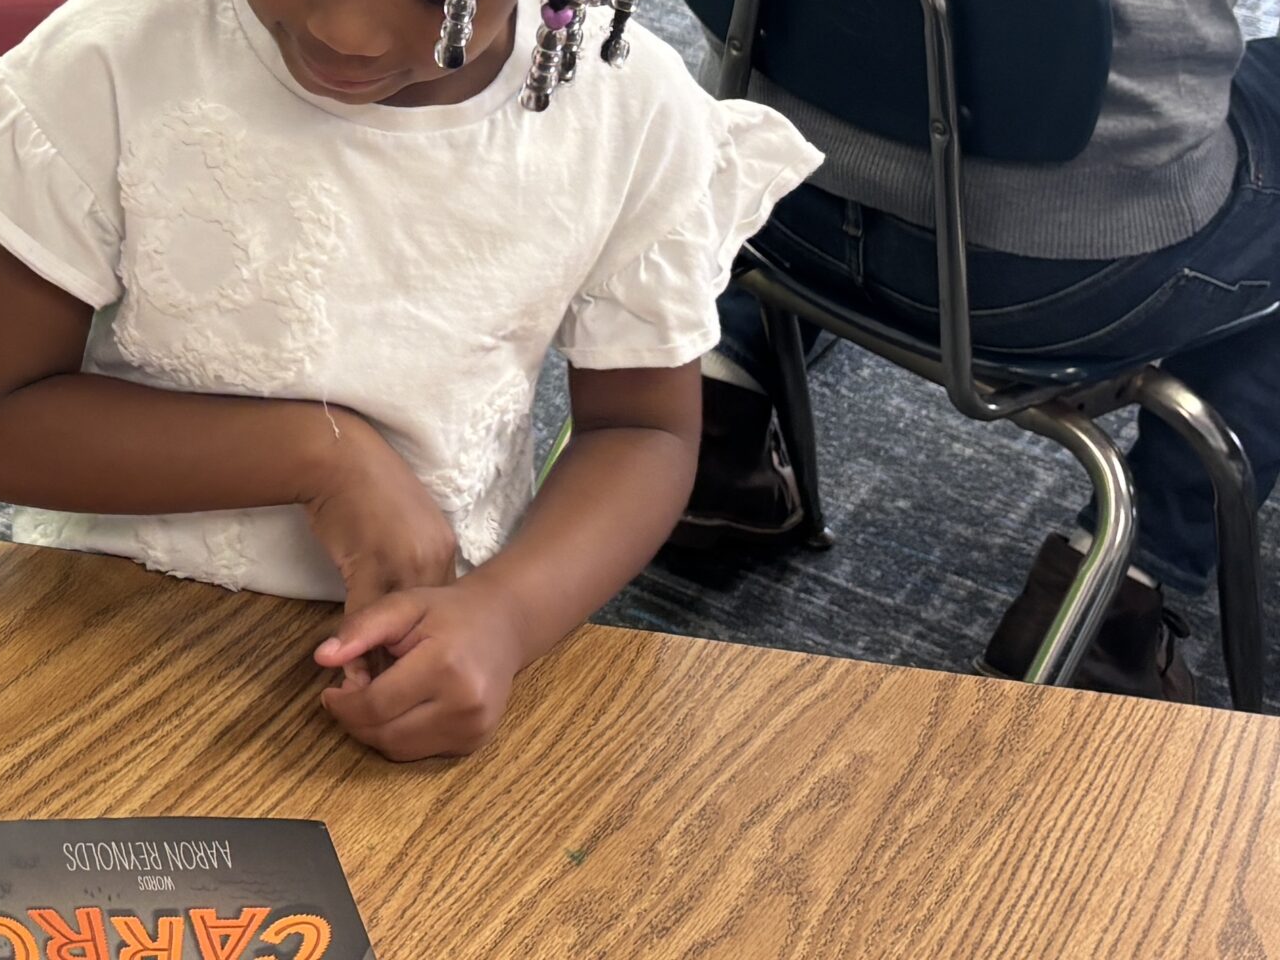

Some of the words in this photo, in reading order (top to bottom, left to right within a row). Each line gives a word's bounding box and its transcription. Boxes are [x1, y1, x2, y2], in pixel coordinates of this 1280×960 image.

[62, 841, 163, 871] REYNOLDS
[163, 839, 233, 871] AARON
[137, 875, 176, 891] WORDS
